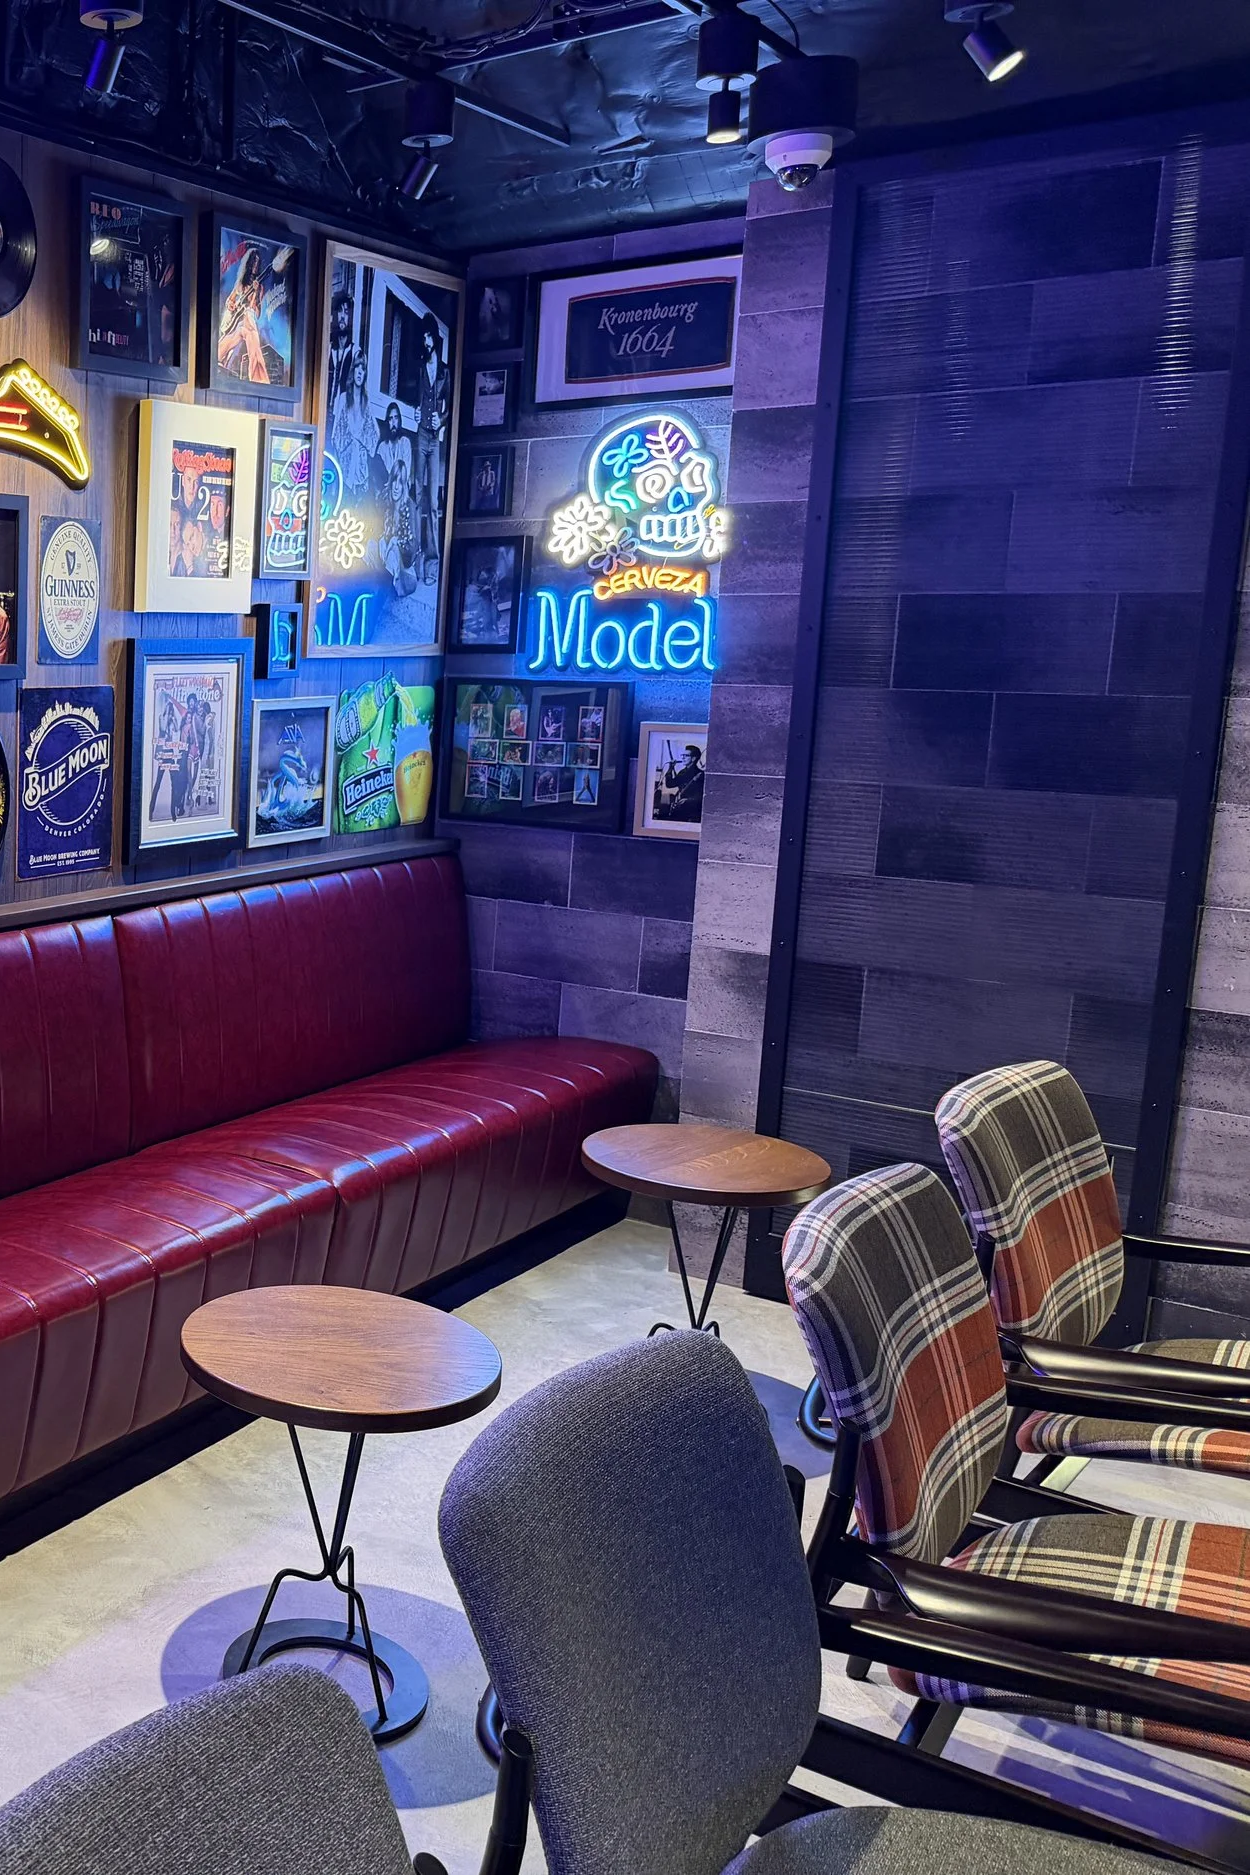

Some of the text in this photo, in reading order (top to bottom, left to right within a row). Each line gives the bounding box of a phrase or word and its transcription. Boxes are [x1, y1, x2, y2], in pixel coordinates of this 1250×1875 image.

[90, 201, 122, 221] REO
[598, 301, 698, 335] Kronenbourg
[617, 324, 676, 358] 1664
[197, 485, 210, 521] 2
[50, 531, 93, 563] GENUINE QUALITY
[46, 574, 95, 599] GUINNESS
[594, 565, 705, 601] CERVEZA
[54, 599, 86, 607] EXTRA STOUT
[65, 639, 79, 650] GATE
[79, 610, 93, 642] DUBLIN
[529, 589, 717, 671] Model
[24, 762, 66, 808] BLUE
[68, 738, 107, 779] MOON
[345, 769, 394, 806] Heineke
[44, 794, 104, 837] DENVER COLORADO
[29, 848, 100, 866] BLUE MOON BREWING COMPANY
